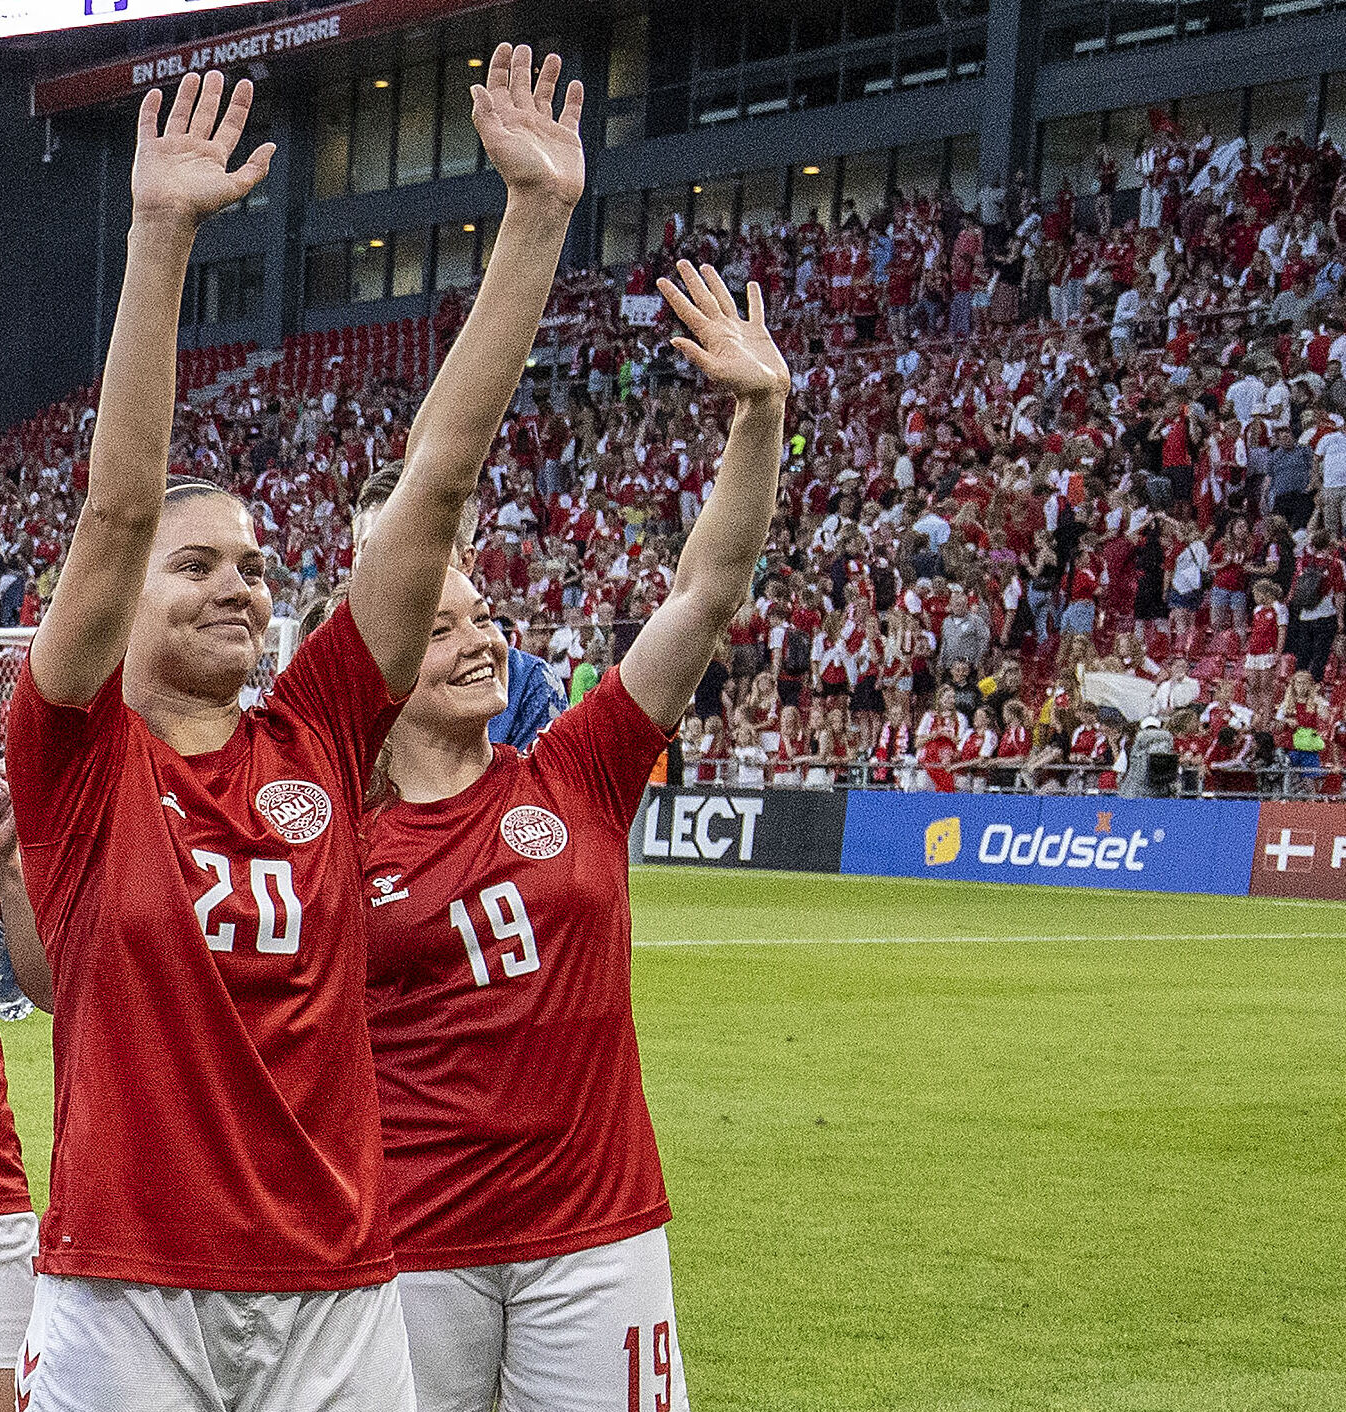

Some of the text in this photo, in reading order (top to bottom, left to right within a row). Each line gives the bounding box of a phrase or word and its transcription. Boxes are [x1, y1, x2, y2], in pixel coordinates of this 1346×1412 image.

[213, 33, 272, 64] NOGET
[273, 15, 341, 51] STØRRE
[270, 795, 315, 826] DBU
[514, 821, 553, 844] DBU
[978, 824, 1149, 872] Oddset
[190, 848, 302, 955] 20
[370, 888, 409, 907] hummel
[449, 881, 541, 987] 19
